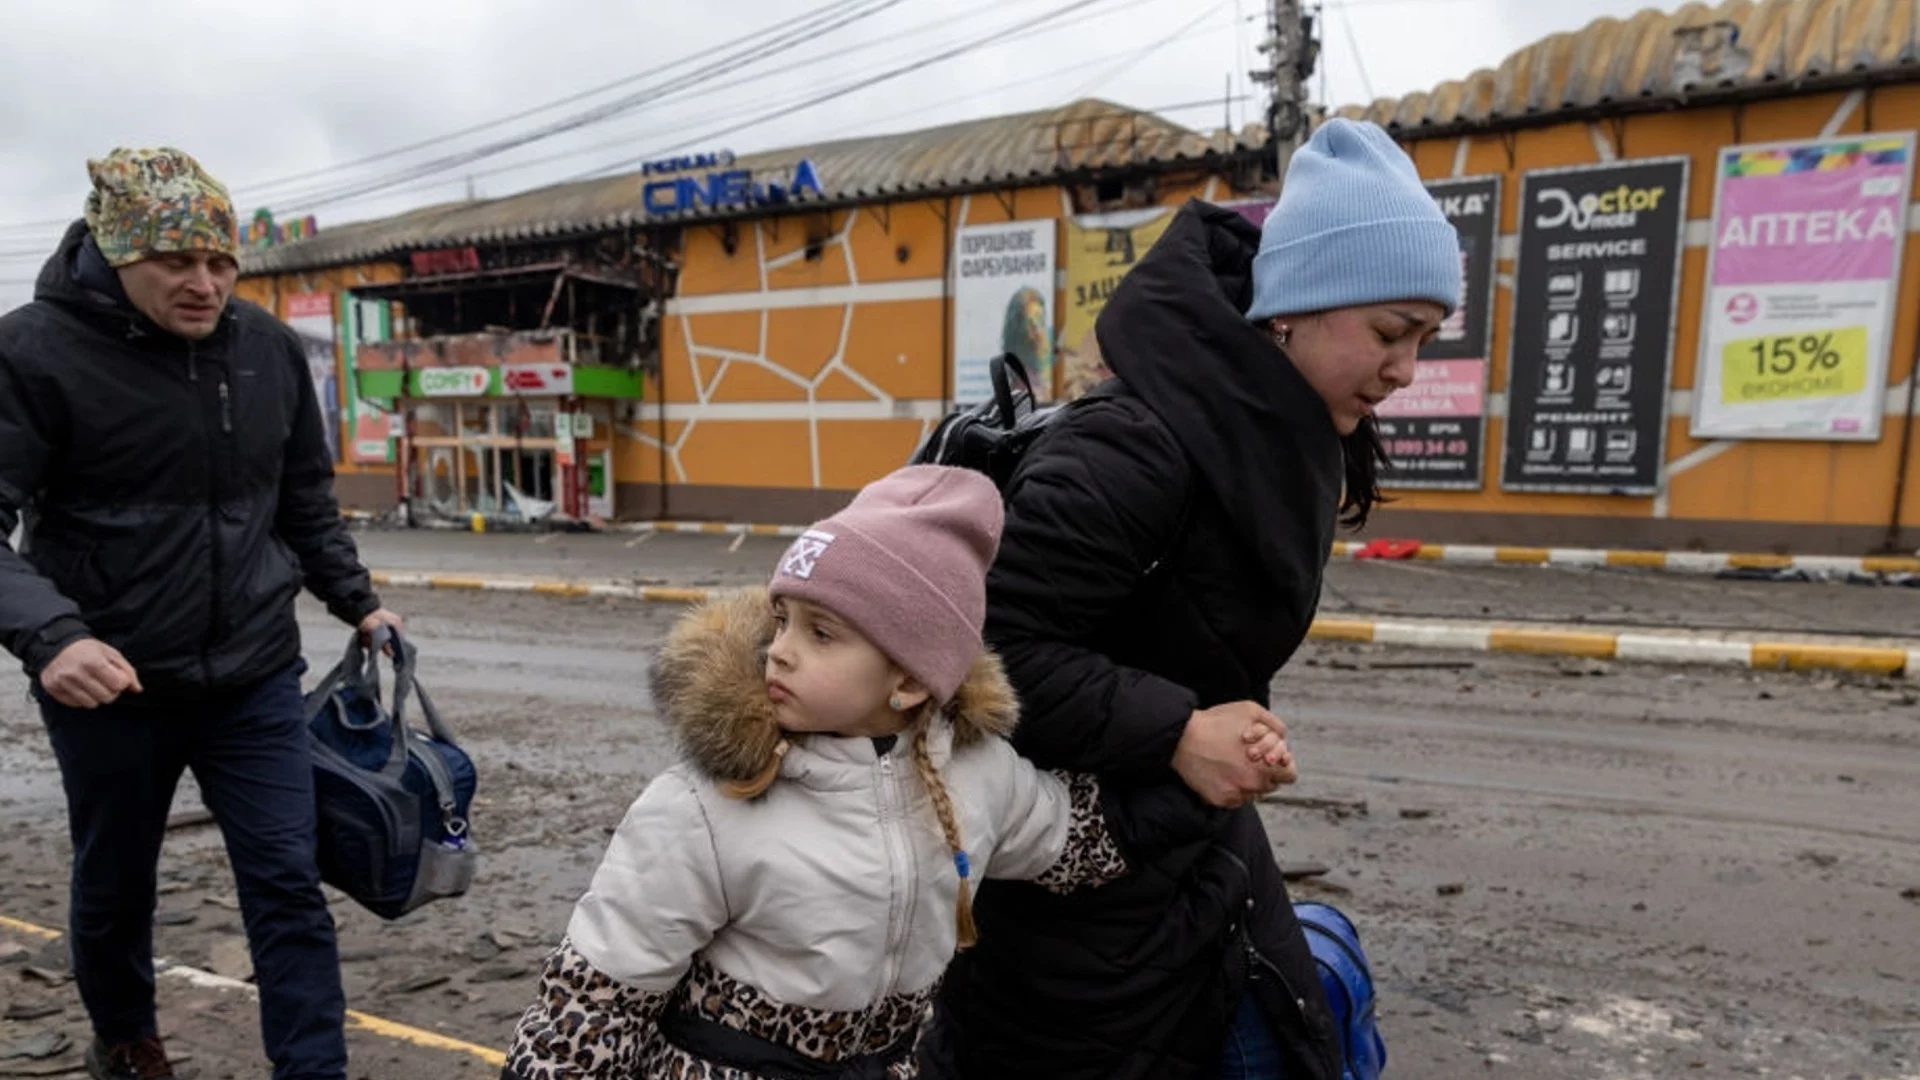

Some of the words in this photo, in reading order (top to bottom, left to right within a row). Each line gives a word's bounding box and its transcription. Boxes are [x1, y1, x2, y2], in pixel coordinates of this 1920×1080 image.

[1437, 194, 1484, 217] КА
[1719, 206, 1897, 249] АПТЕКА
[1547, 238, 1647, 261] SERVICE
[1749, 331, 1841, 376] 15%
[1534, 411, 1631, 424] РЕМОНТ
